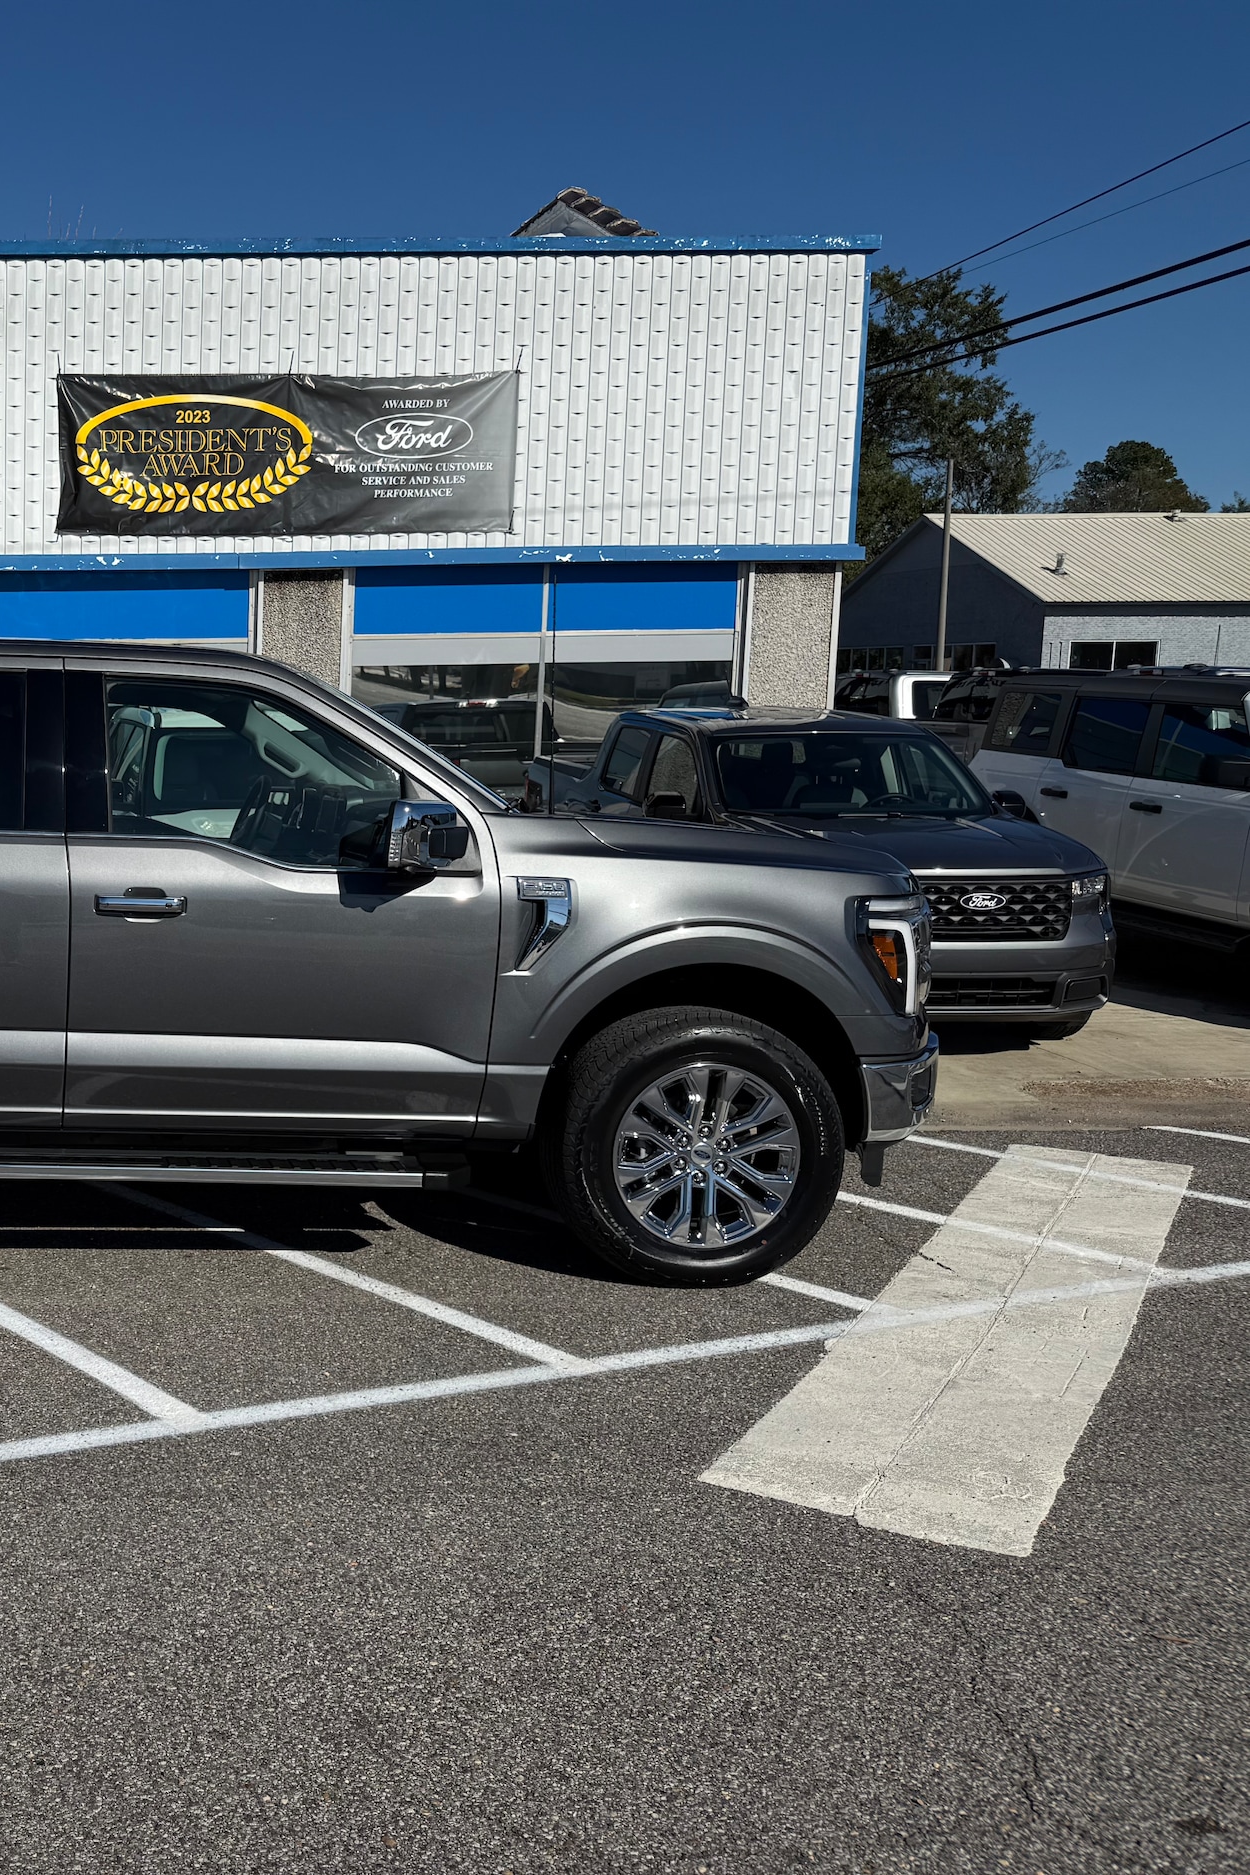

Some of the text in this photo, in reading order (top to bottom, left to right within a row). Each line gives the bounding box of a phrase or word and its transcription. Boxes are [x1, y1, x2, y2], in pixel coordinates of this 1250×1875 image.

[382, 399, 450, 409] AWARDED BY
[175, 409, 211, 424] 2023
[98, 426, 292, 453] PRESIDENT'S
[375, 419, 453, 450] Ford
[139, 452, 245, 477] AWARD
[334, 462, 494, 473] FOR OUTSTANDING CUSTOMER
[361, 475, 466, 486] SERVICE AND SALES
[373, 488, 453, 498] PERFORMANCE
[968, 895, 998, 907] Ford
